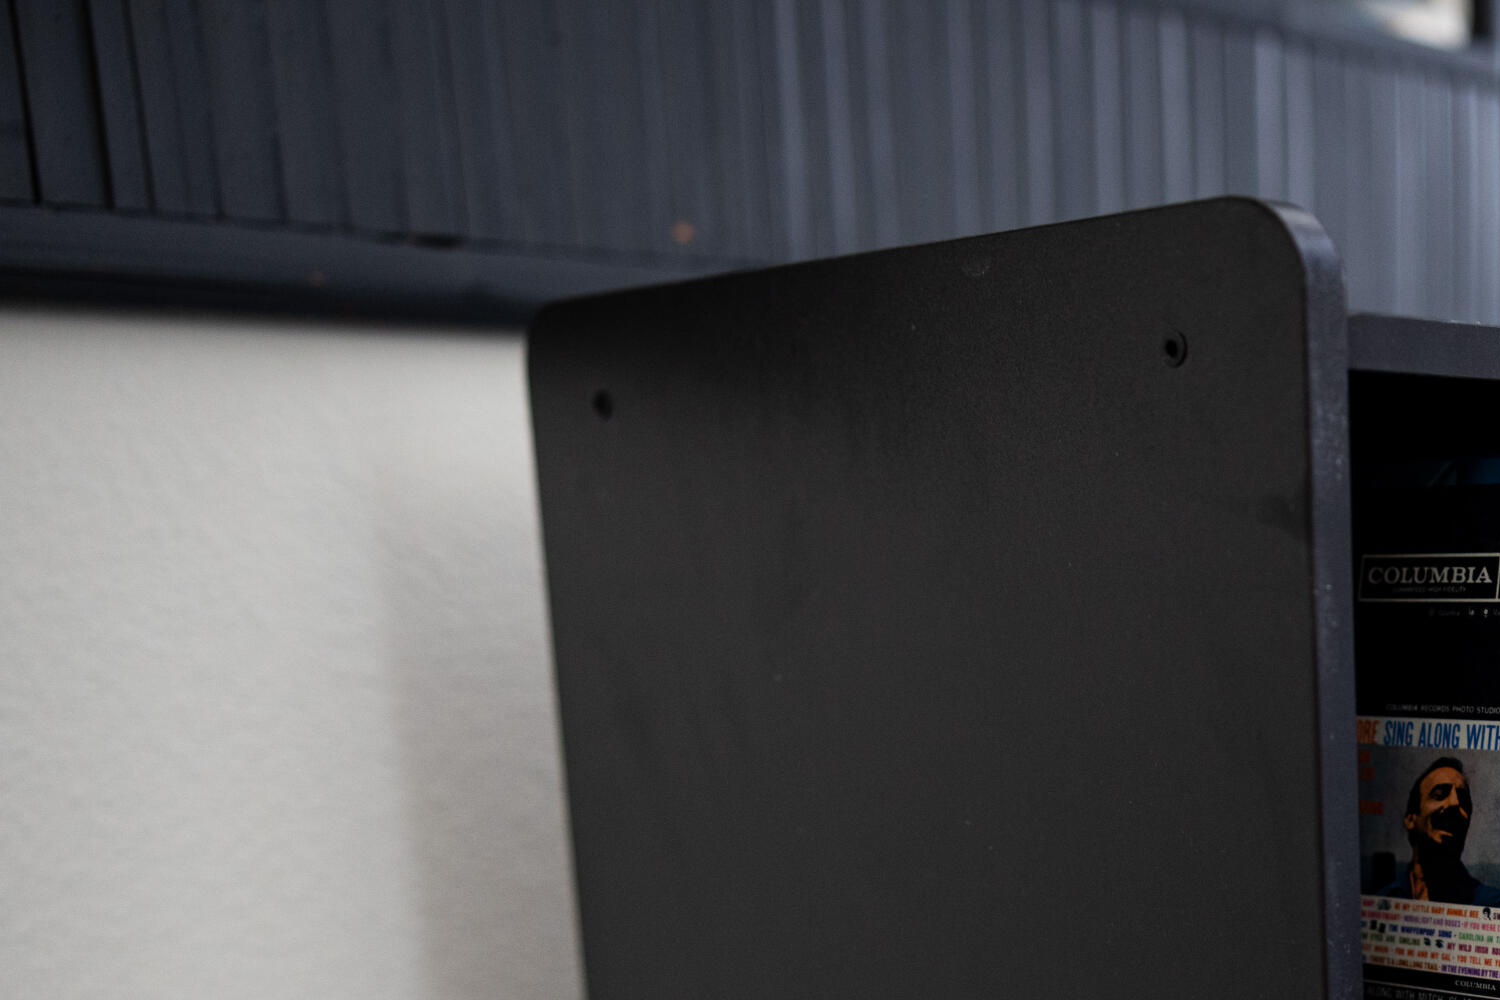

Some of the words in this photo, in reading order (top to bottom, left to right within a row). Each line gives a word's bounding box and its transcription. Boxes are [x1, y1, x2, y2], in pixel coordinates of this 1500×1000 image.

[1368, 565, 1493, 585] COLUMBIA
[1452, 705, 1475, 714] PHOTO
[1384, 719, 1415, 747] SING
[1418, 722, 1461, 749] ALONG
[1458, 931, 1484, 941] CAROLINA
[1469, 955, 1480, 964] TELL
